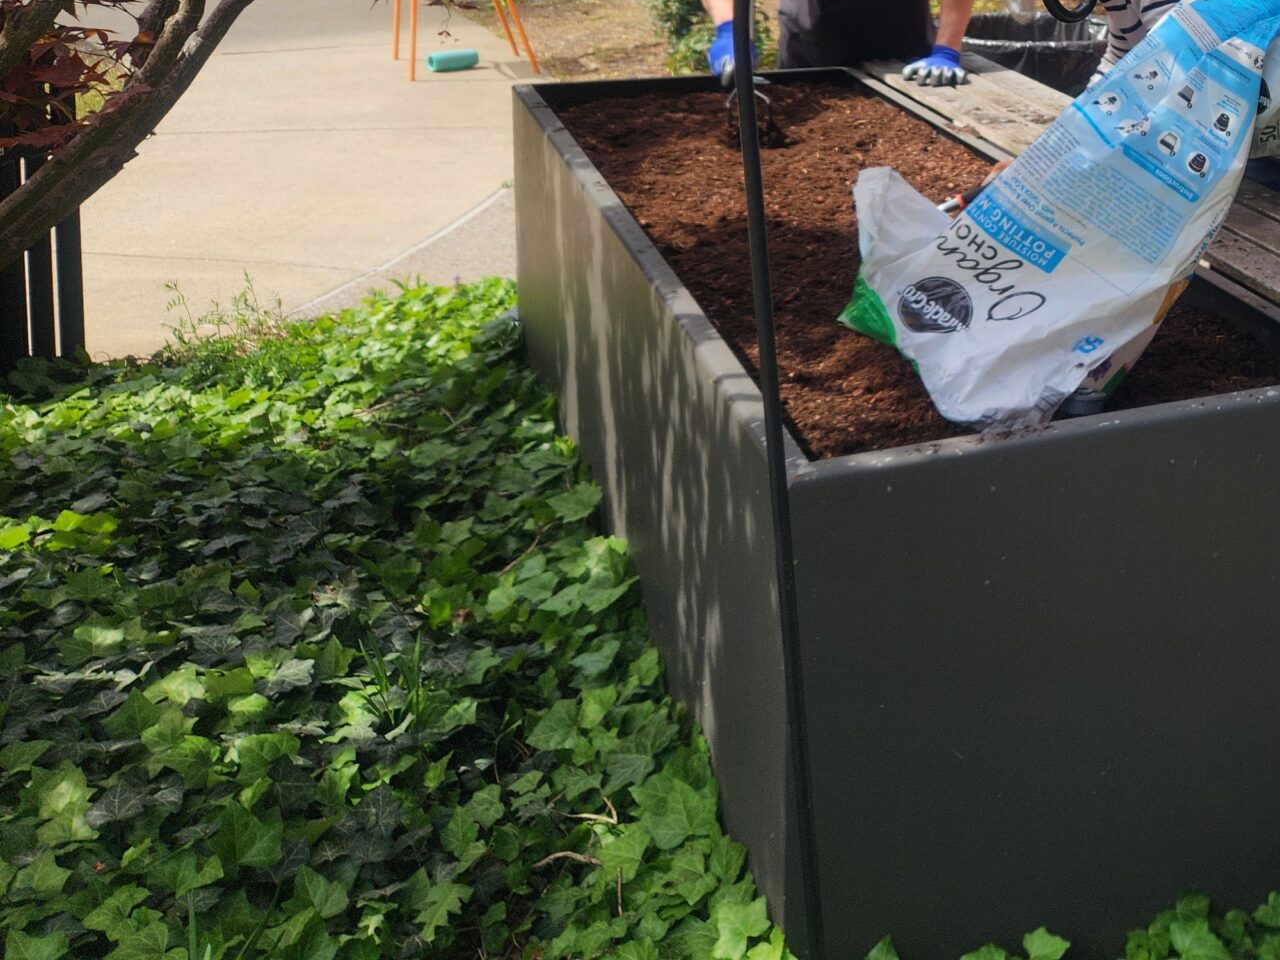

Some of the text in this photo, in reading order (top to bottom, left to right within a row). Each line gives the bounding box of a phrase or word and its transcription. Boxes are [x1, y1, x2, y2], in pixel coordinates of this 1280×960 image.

[1153, 168, 1194, 199] Instructions
[989, 206, 1056, 259] POTTING
[996, 229, 1049, 266] MOISTURE
